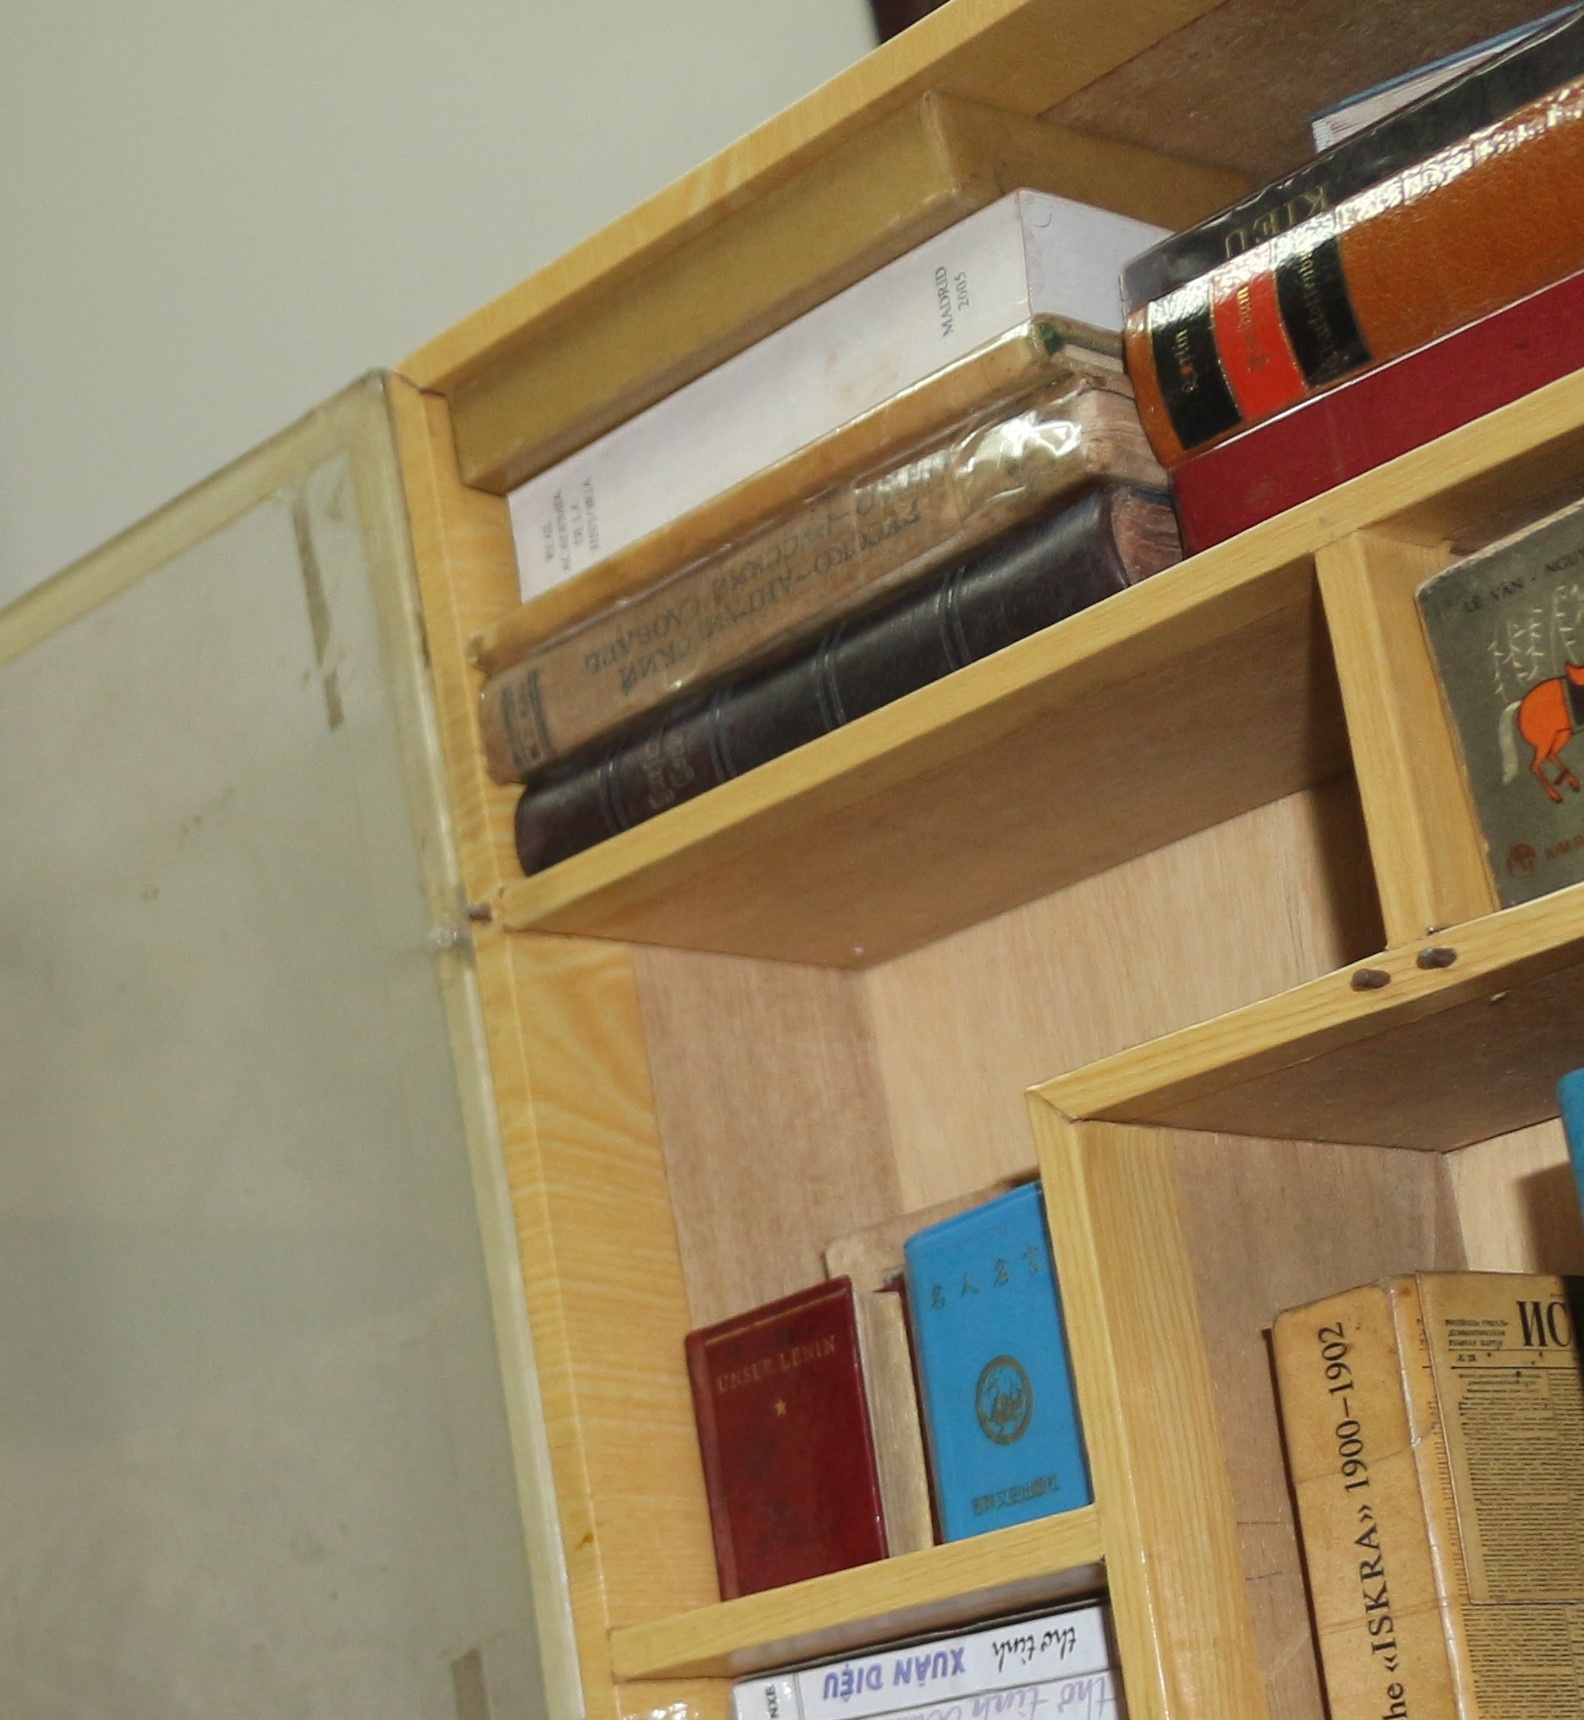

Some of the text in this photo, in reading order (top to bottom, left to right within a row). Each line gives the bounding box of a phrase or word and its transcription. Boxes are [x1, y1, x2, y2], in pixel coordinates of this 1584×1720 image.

[935, 265, 952, 337] MADRID
[954, 271, 970, 312] 2005
[780, 1334, 836, 1371] LENIN
[1353, 1504, 1400, 1675] «ISKRA»
[894, 1647, 966, 1687] XUÂN
